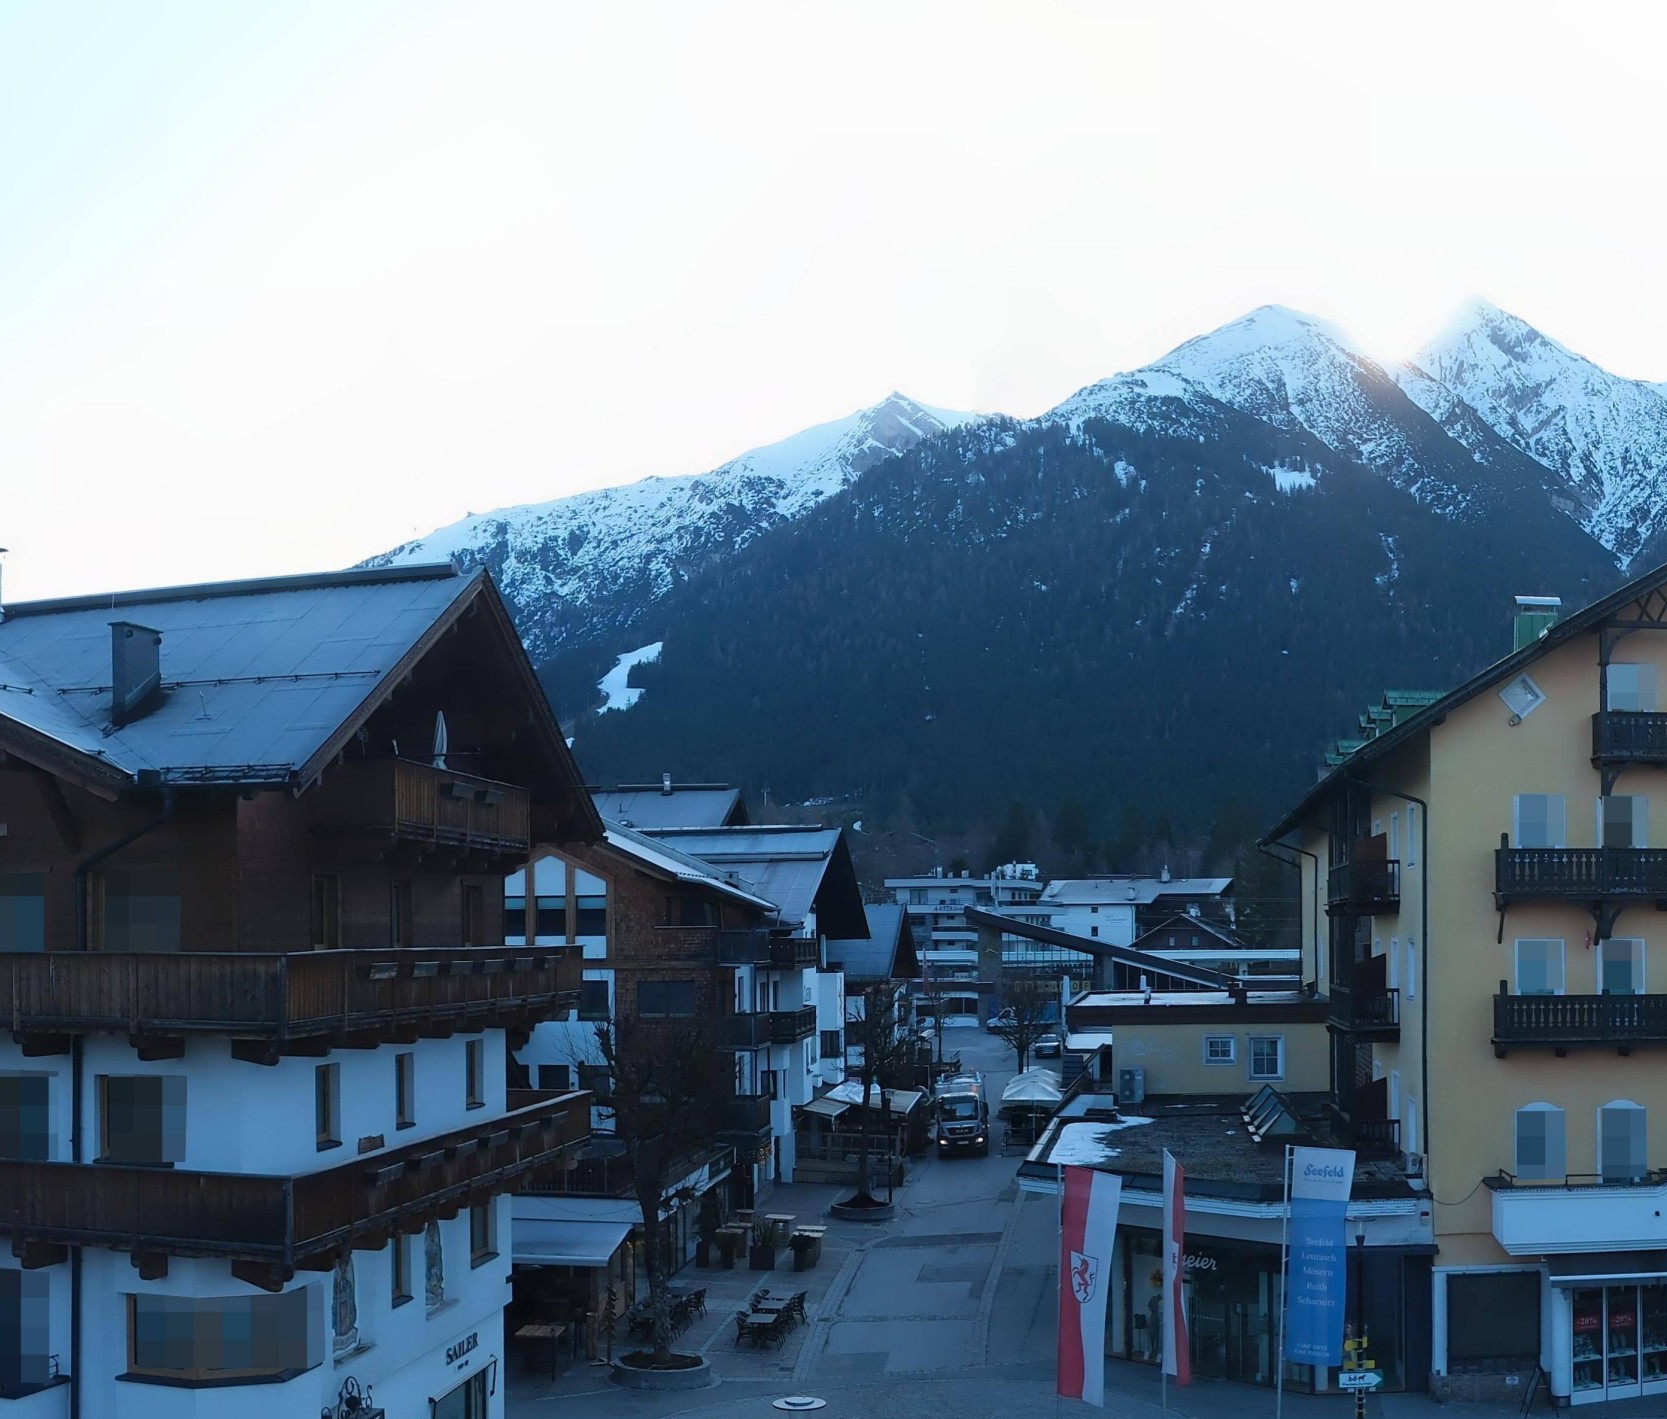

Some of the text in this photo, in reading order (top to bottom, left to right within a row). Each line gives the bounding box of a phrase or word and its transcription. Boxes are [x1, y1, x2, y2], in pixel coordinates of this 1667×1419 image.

[1304, 1163, 1344, 1178] Seefeld
[1306, 1237, 1334, 1247] Seefeld
[1301, 1252, 1337, 1262] Leutasch
[1297, 1296, 1336, 1307] Scharnitz
[446, 1332, 479, 1366] SAILER
